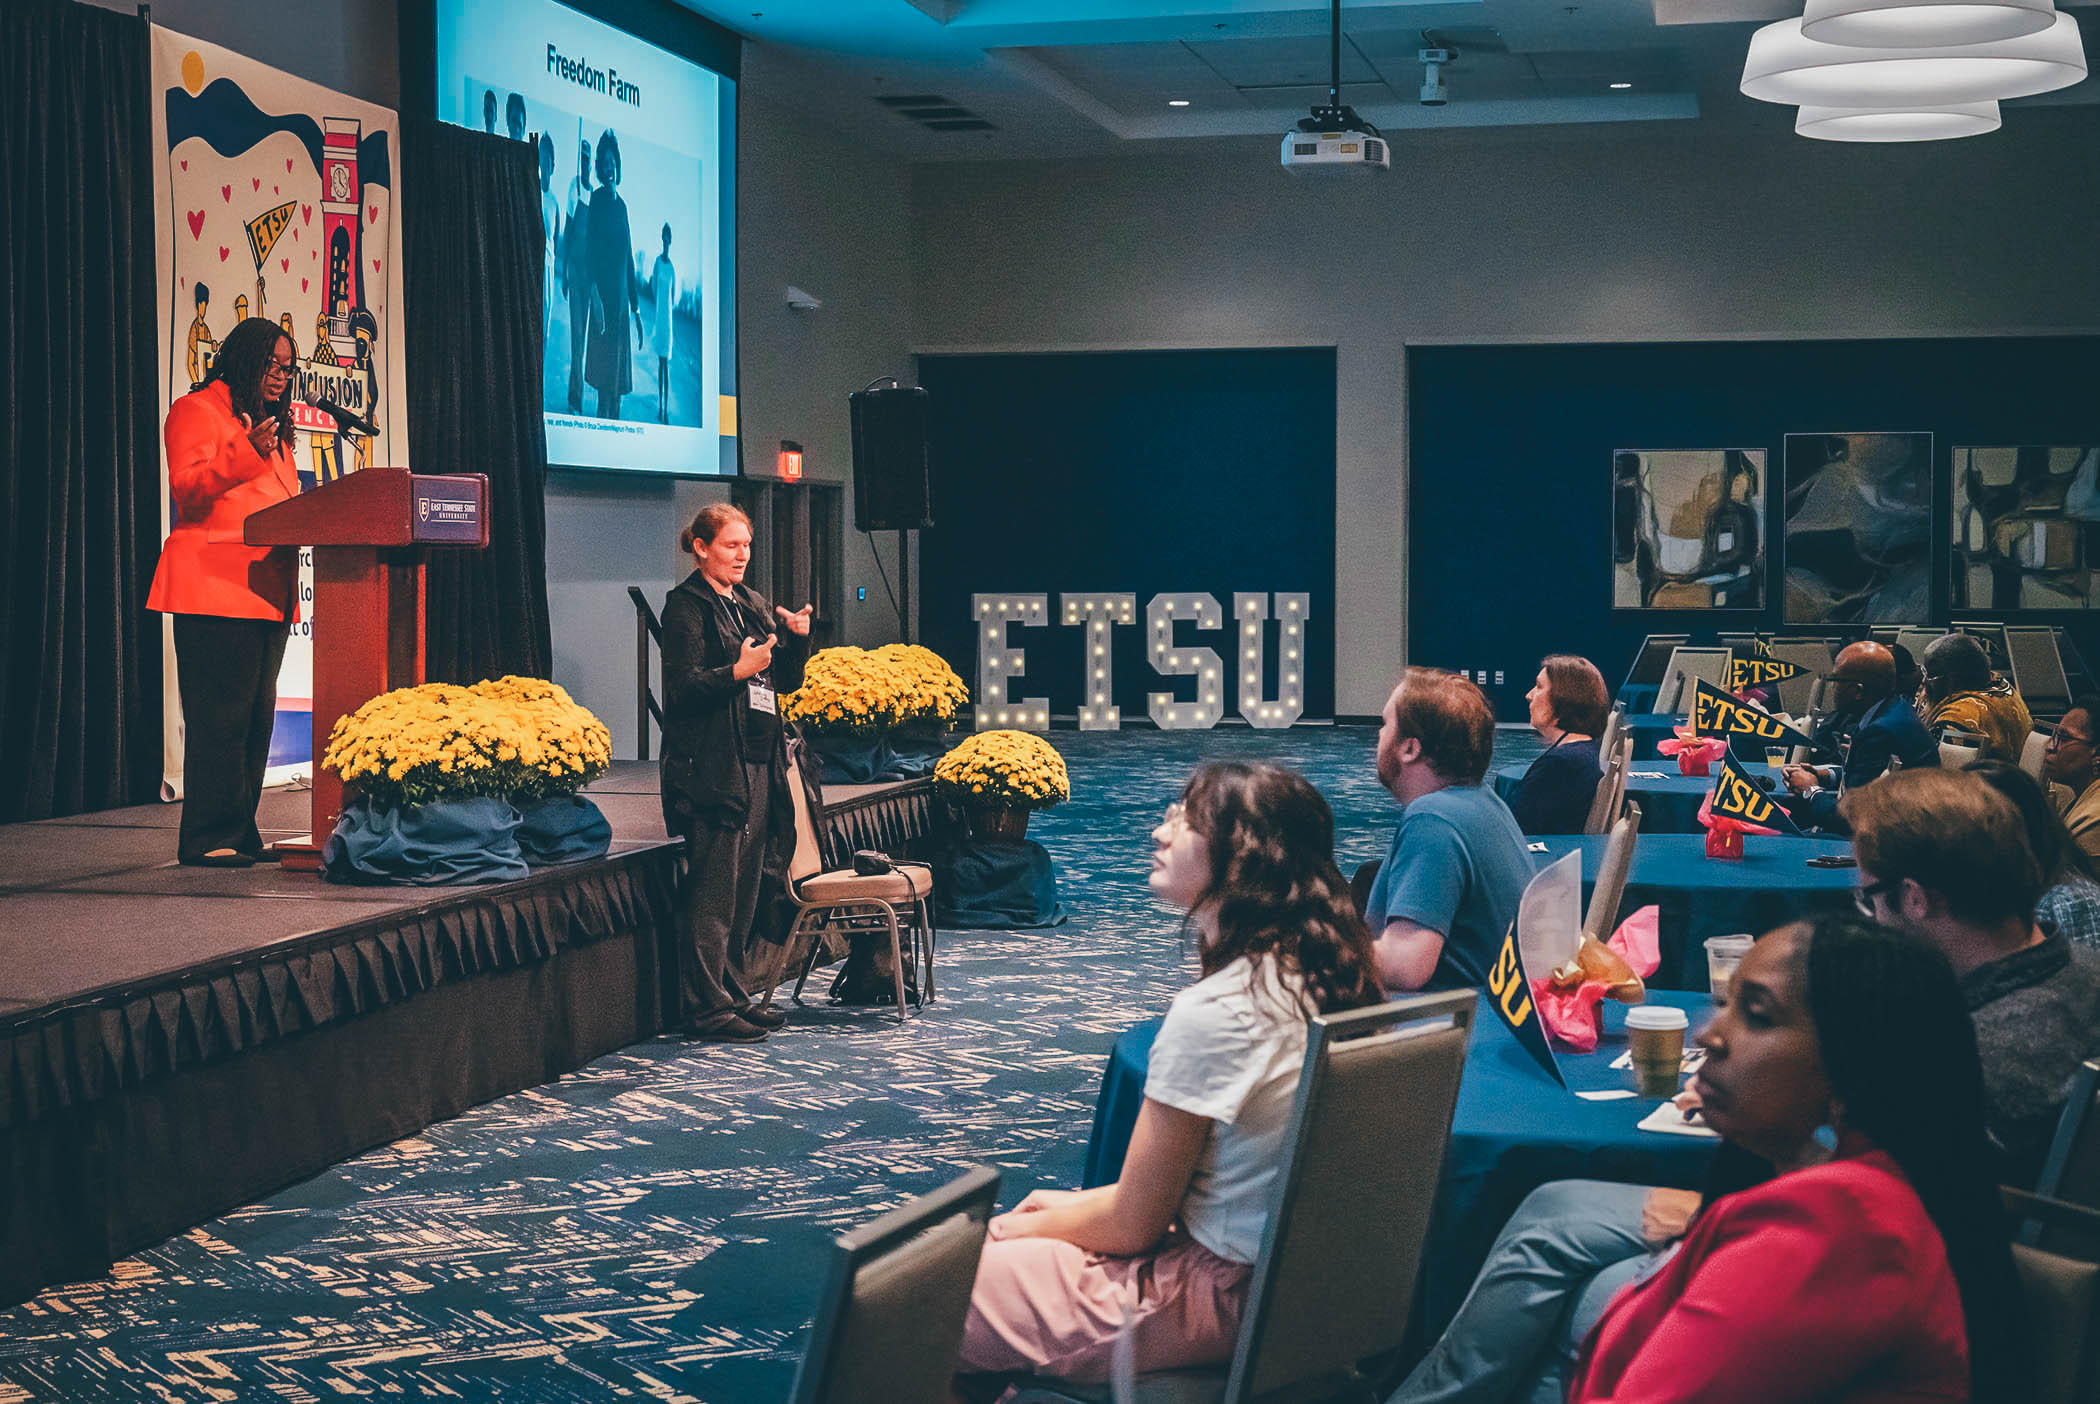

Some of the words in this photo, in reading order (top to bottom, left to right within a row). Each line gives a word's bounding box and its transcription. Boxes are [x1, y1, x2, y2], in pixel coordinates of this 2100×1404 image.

[546, 43, 606, 95] Freedom
[608, 68, 640, 108] Farm
[255, 208, 289, 254] ETSU
[972, 592, 1310, 731] ETSU
[1732, 659, 1794, 688] ETSU
[1697, 691, 1786, 739] ETSU
[1712, 760, 1775, 823] TSU
